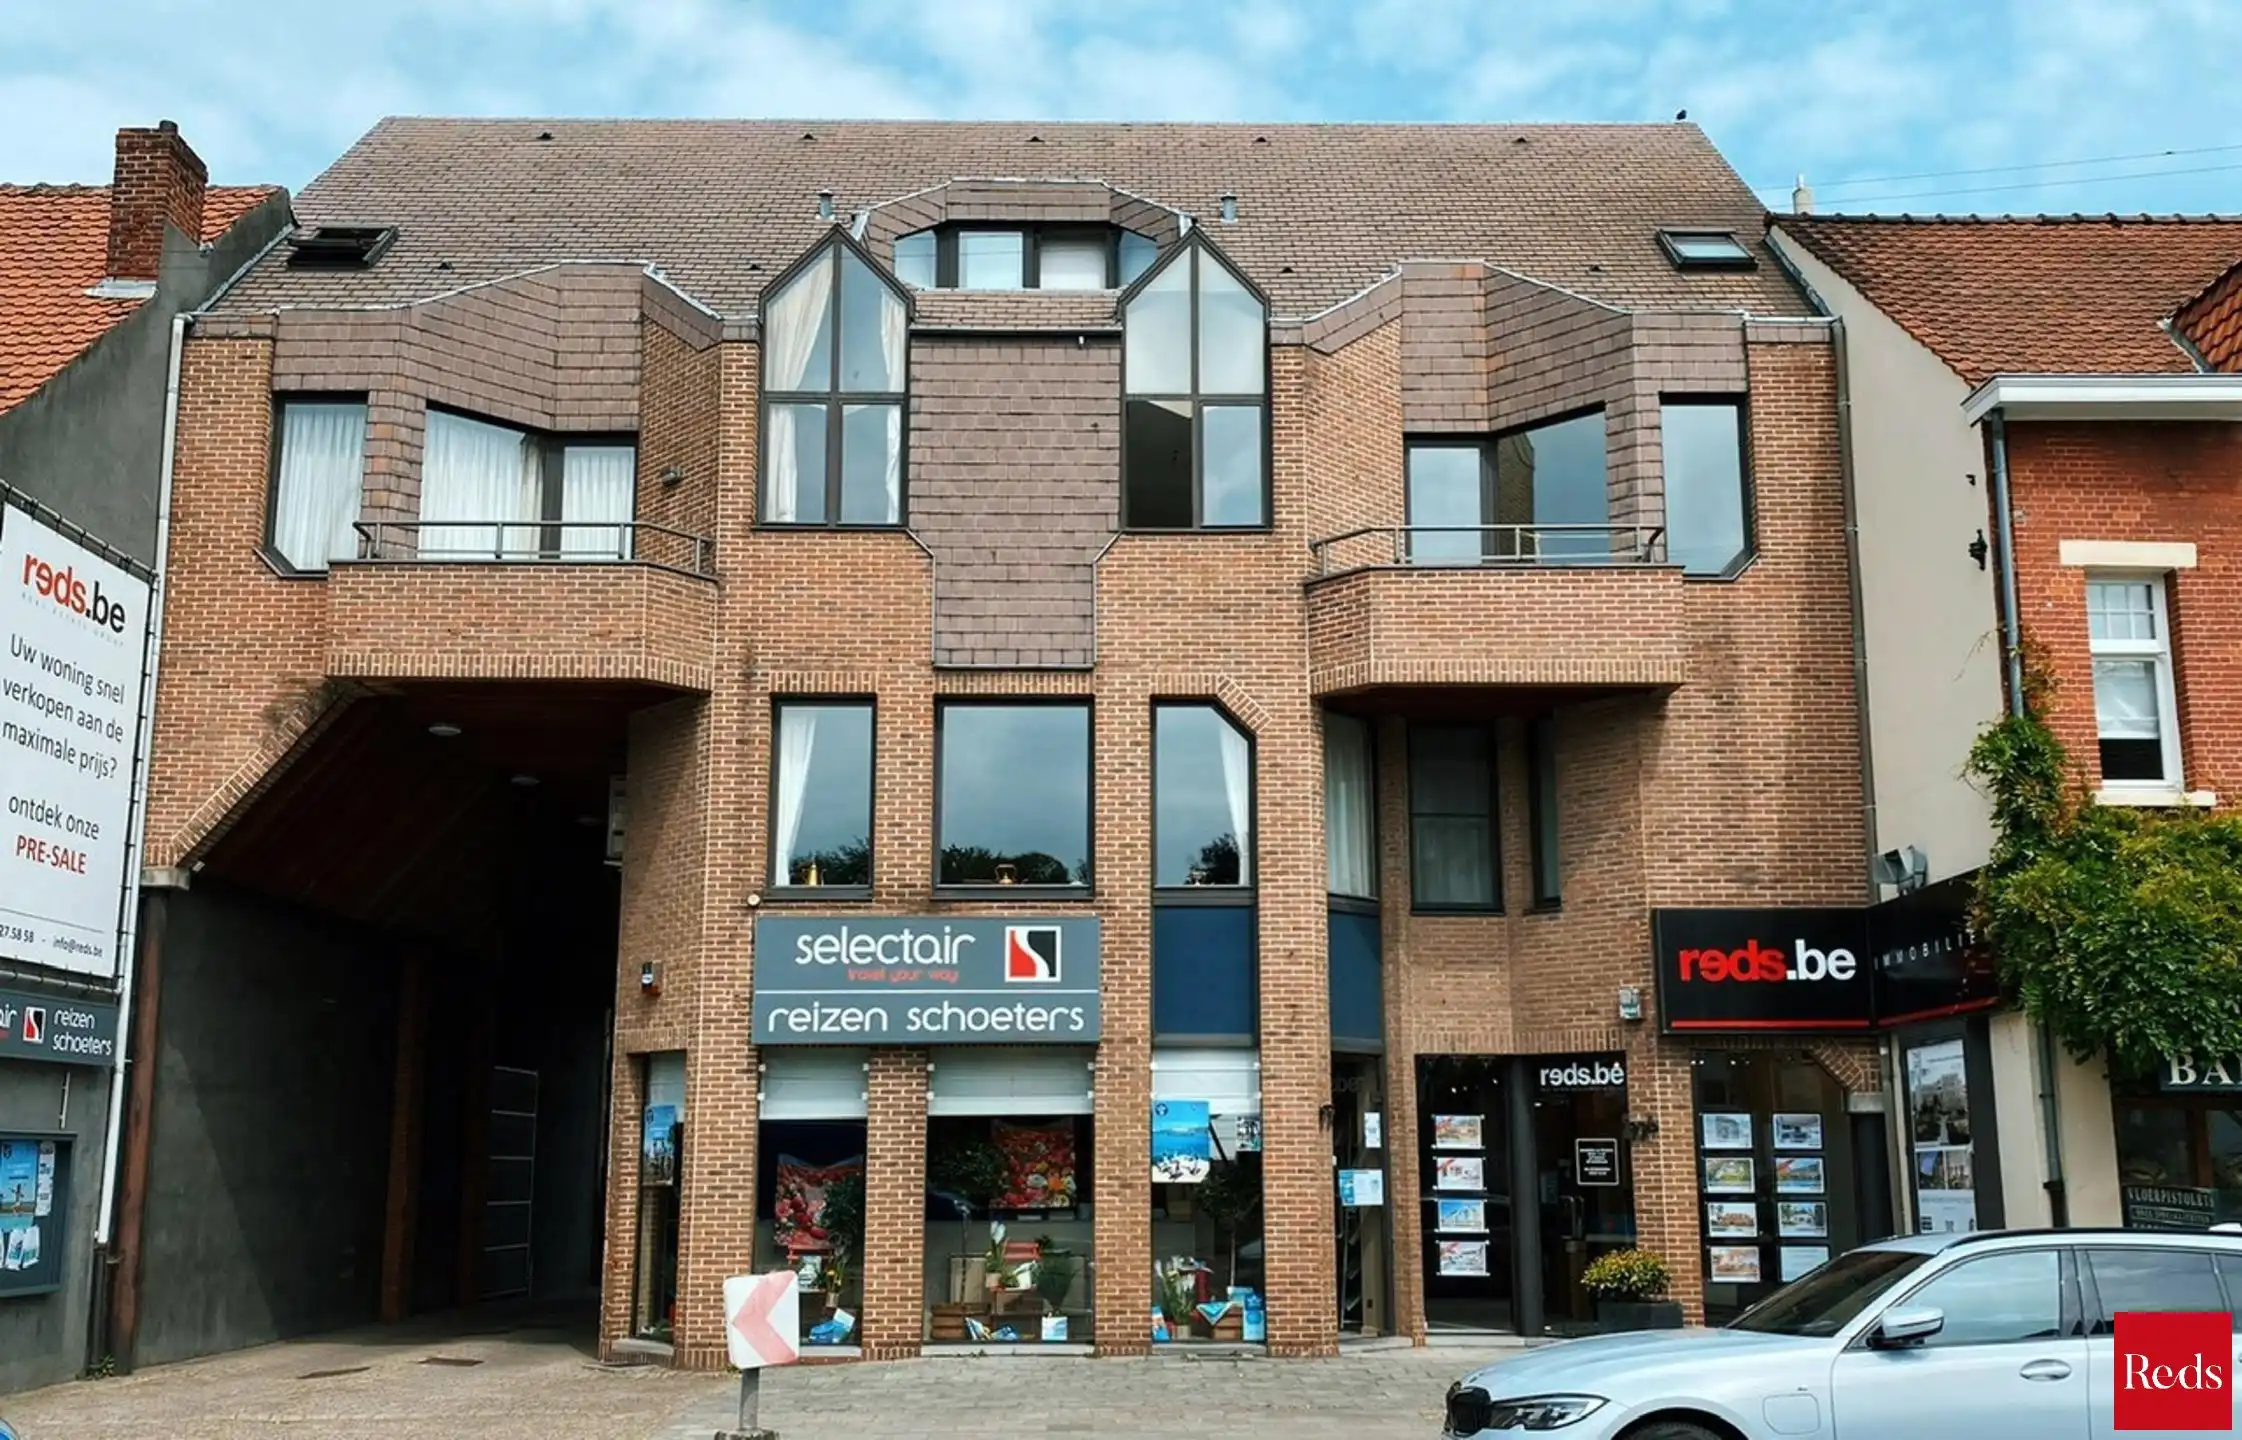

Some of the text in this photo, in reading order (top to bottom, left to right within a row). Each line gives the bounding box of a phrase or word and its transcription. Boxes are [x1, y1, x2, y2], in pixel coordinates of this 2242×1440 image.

[23, 552, 126, 634] reds.be
[10, 633, 125, 705] Uw woning snel
[3, 678, 124, 743] verkopen aan de
[2, 720, 118, 780] maximale prijs?
[8, 796, 100, 840] ontdek onze
[16, 834, 87, 874] PRE-SALE
[795, 926, 976, 965] selectair
[1679, 938, 1857, 983] reds.be
[53, 1008, 96, 1029] reizen
[768, 1001, 1085, 1033] reizen schoeters
[52, 1032, 112, 1056] schoeters
